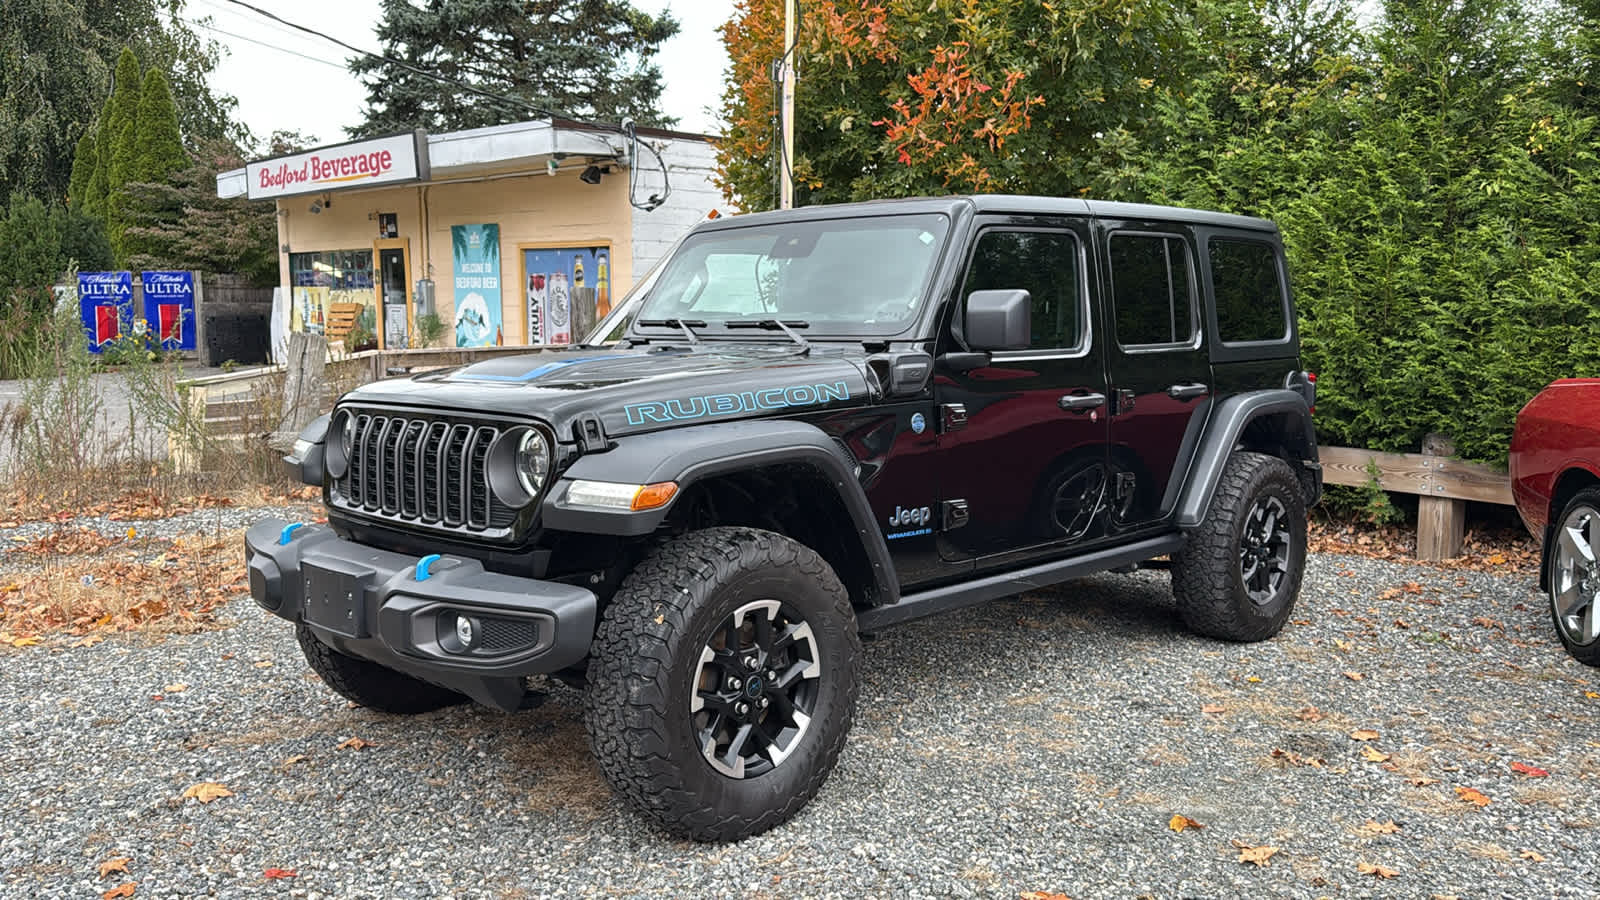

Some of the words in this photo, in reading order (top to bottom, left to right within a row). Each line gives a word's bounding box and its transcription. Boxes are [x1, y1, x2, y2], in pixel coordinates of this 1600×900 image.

[259, 161, 308, 189] Bedford
[310, 150, 392, 177] Beverage
[462, 263, 483, 273] WELCOME
[81, 284, 130, 295] ULTRA
[145, 282, 192, 294] ULTRA
[455, 276, 481, 289] BEDFORD
[482, 276, 498, 289] BEER
[531, 297, 540, 344] TRULY
[624, 381, 851, 426] RUBICON
[889, 505, 931, 527] Jeep
